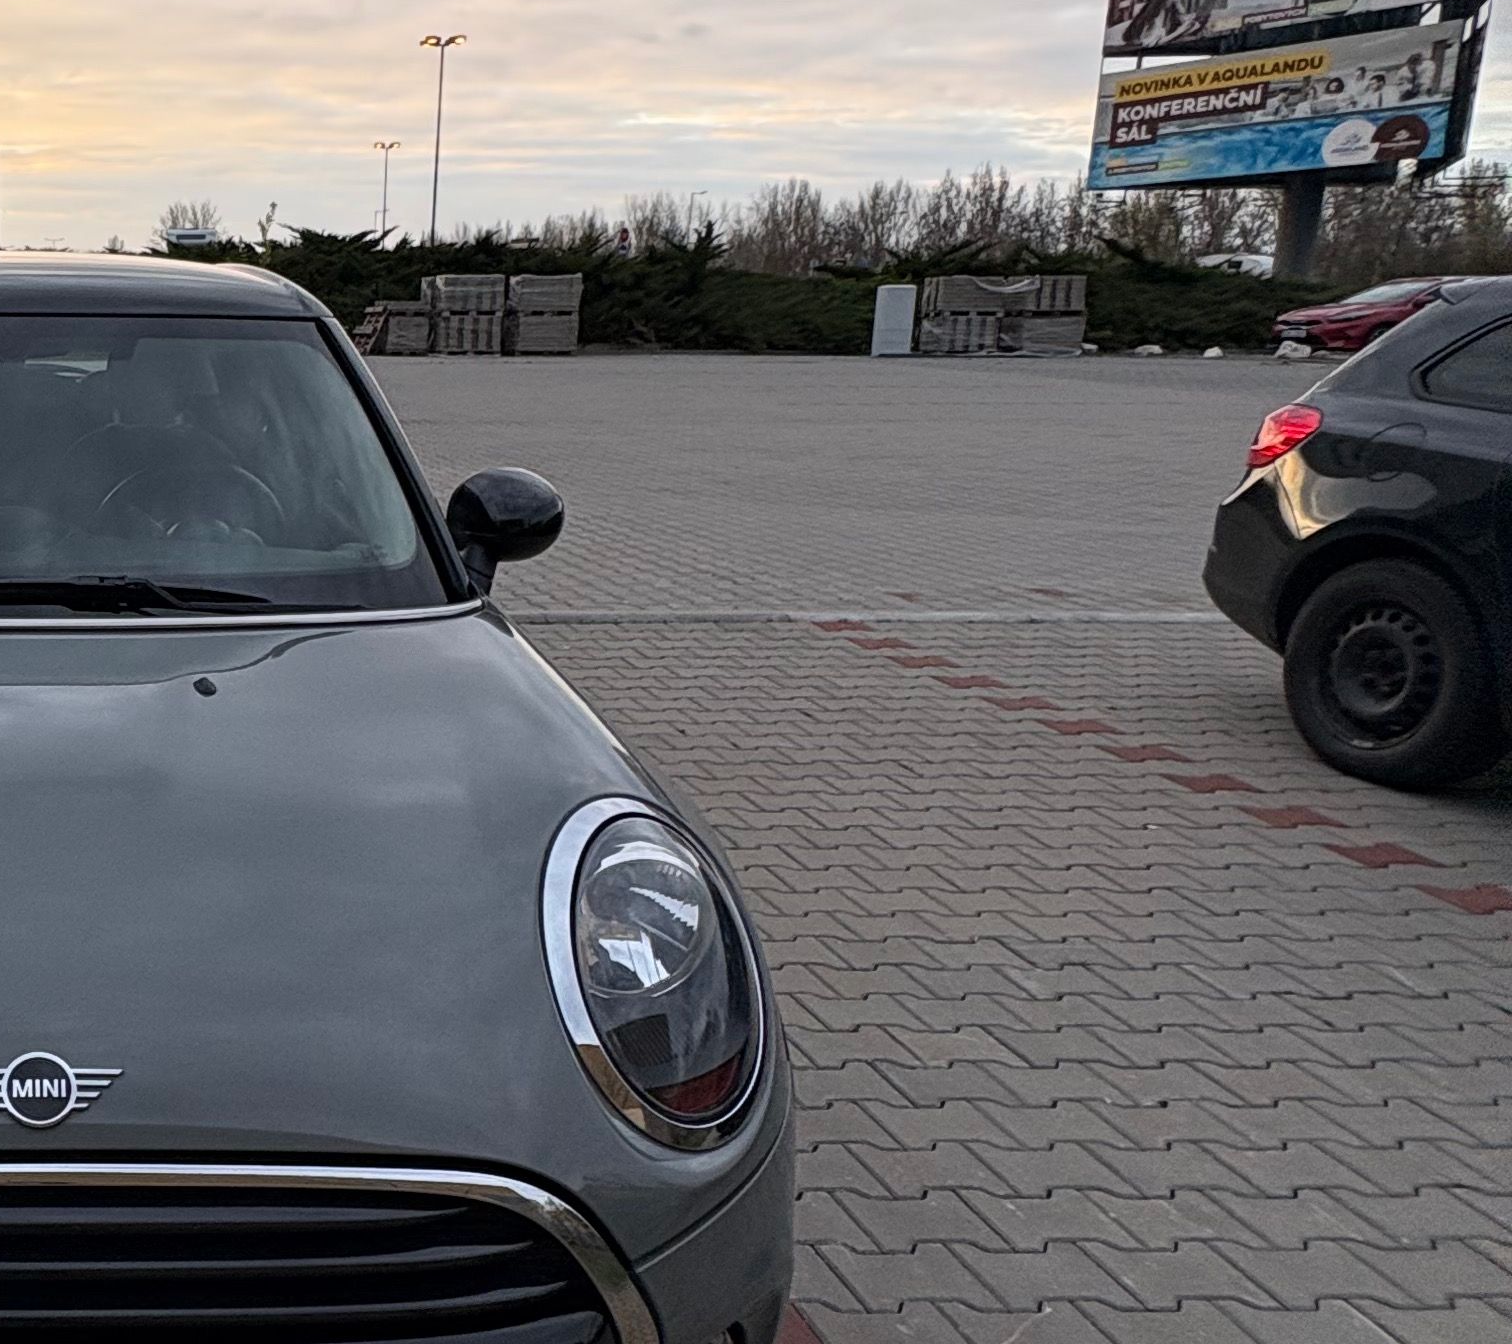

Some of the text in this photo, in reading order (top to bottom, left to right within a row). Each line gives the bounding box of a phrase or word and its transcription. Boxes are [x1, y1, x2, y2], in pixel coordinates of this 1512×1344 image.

[1119, 55, 1324, 97] NOVINKA V AQUALANDU
[1117, 84, 1265, 124] KONFERENČNÍ
[1115, 120, 1152, 144] SÁL
[12, 1078, 67, 1098] MINI
